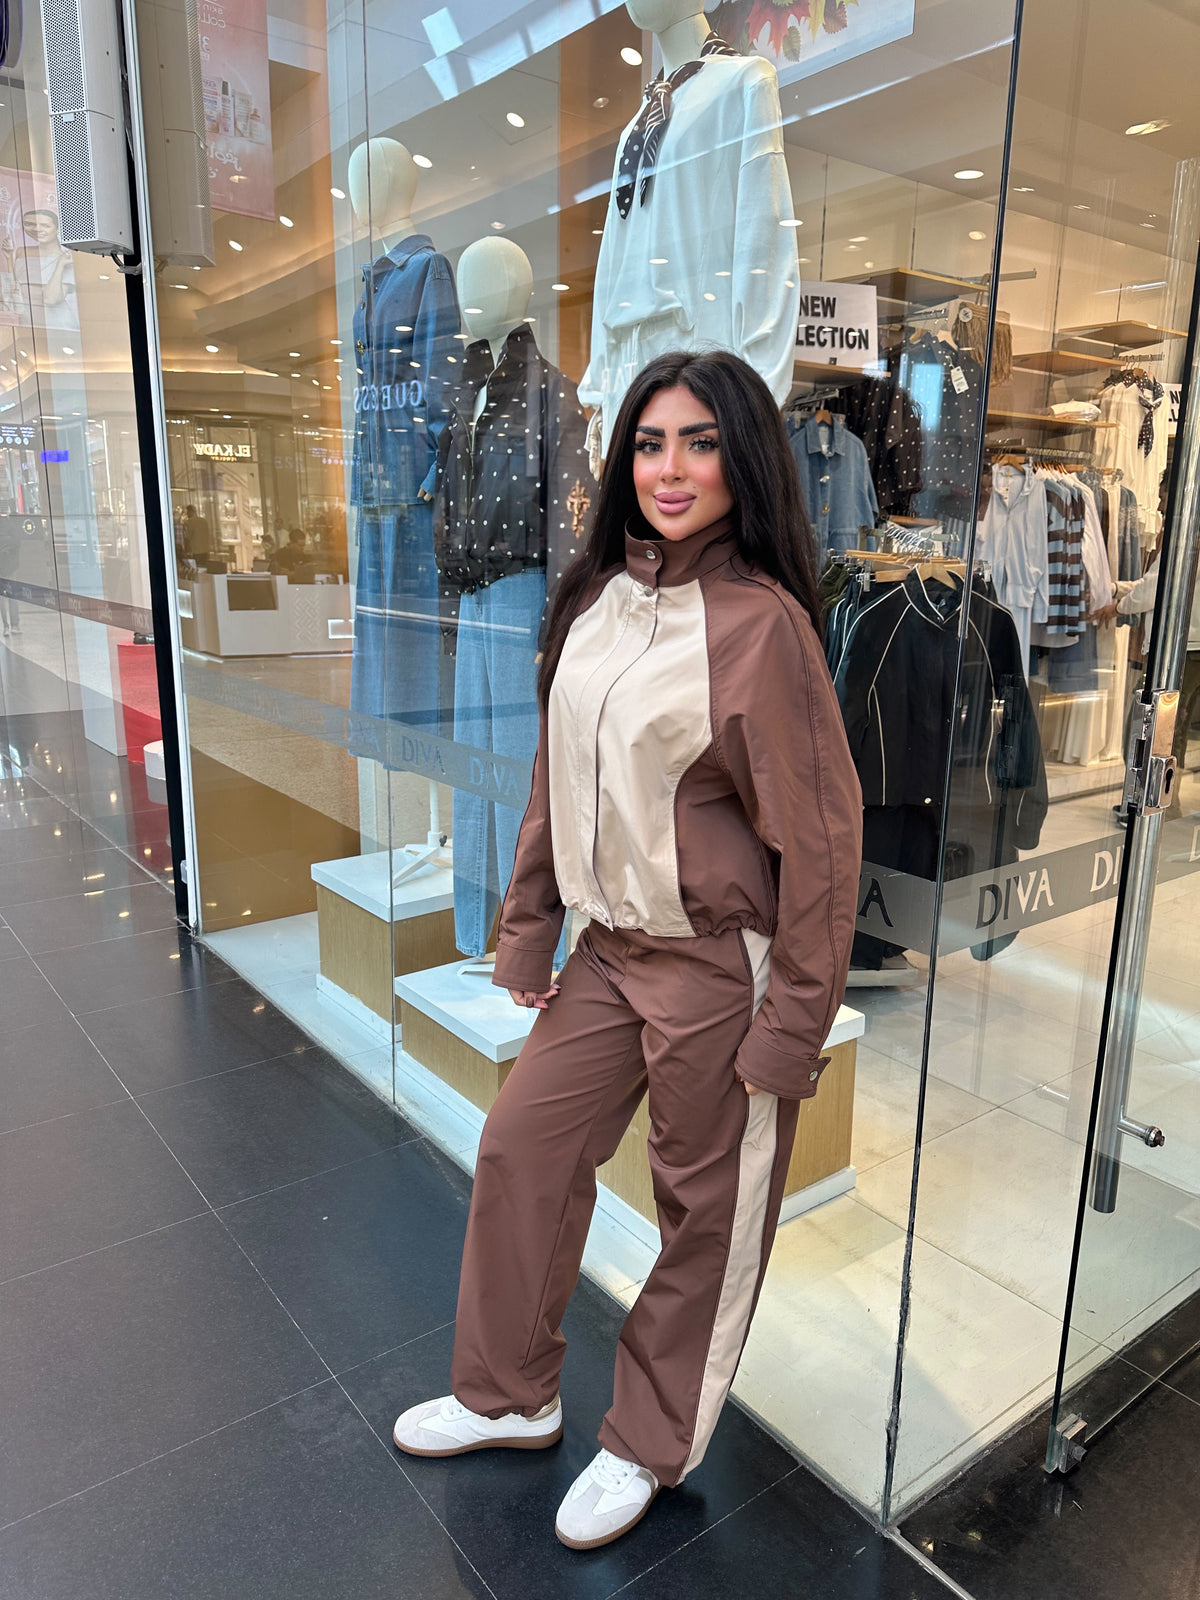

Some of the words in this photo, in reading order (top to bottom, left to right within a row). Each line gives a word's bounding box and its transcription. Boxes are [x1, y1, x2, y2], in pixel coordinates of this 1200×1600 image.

[799, 295, 836, 318] NEW
[795, 325, 869, 350] LECTION
[402, 735, 446, 775] DIVA
[469, 755, 521, 797] DIVA
[975, 867, 1055, 930] DIVA
[1090, 845, 1124, 893] DI
